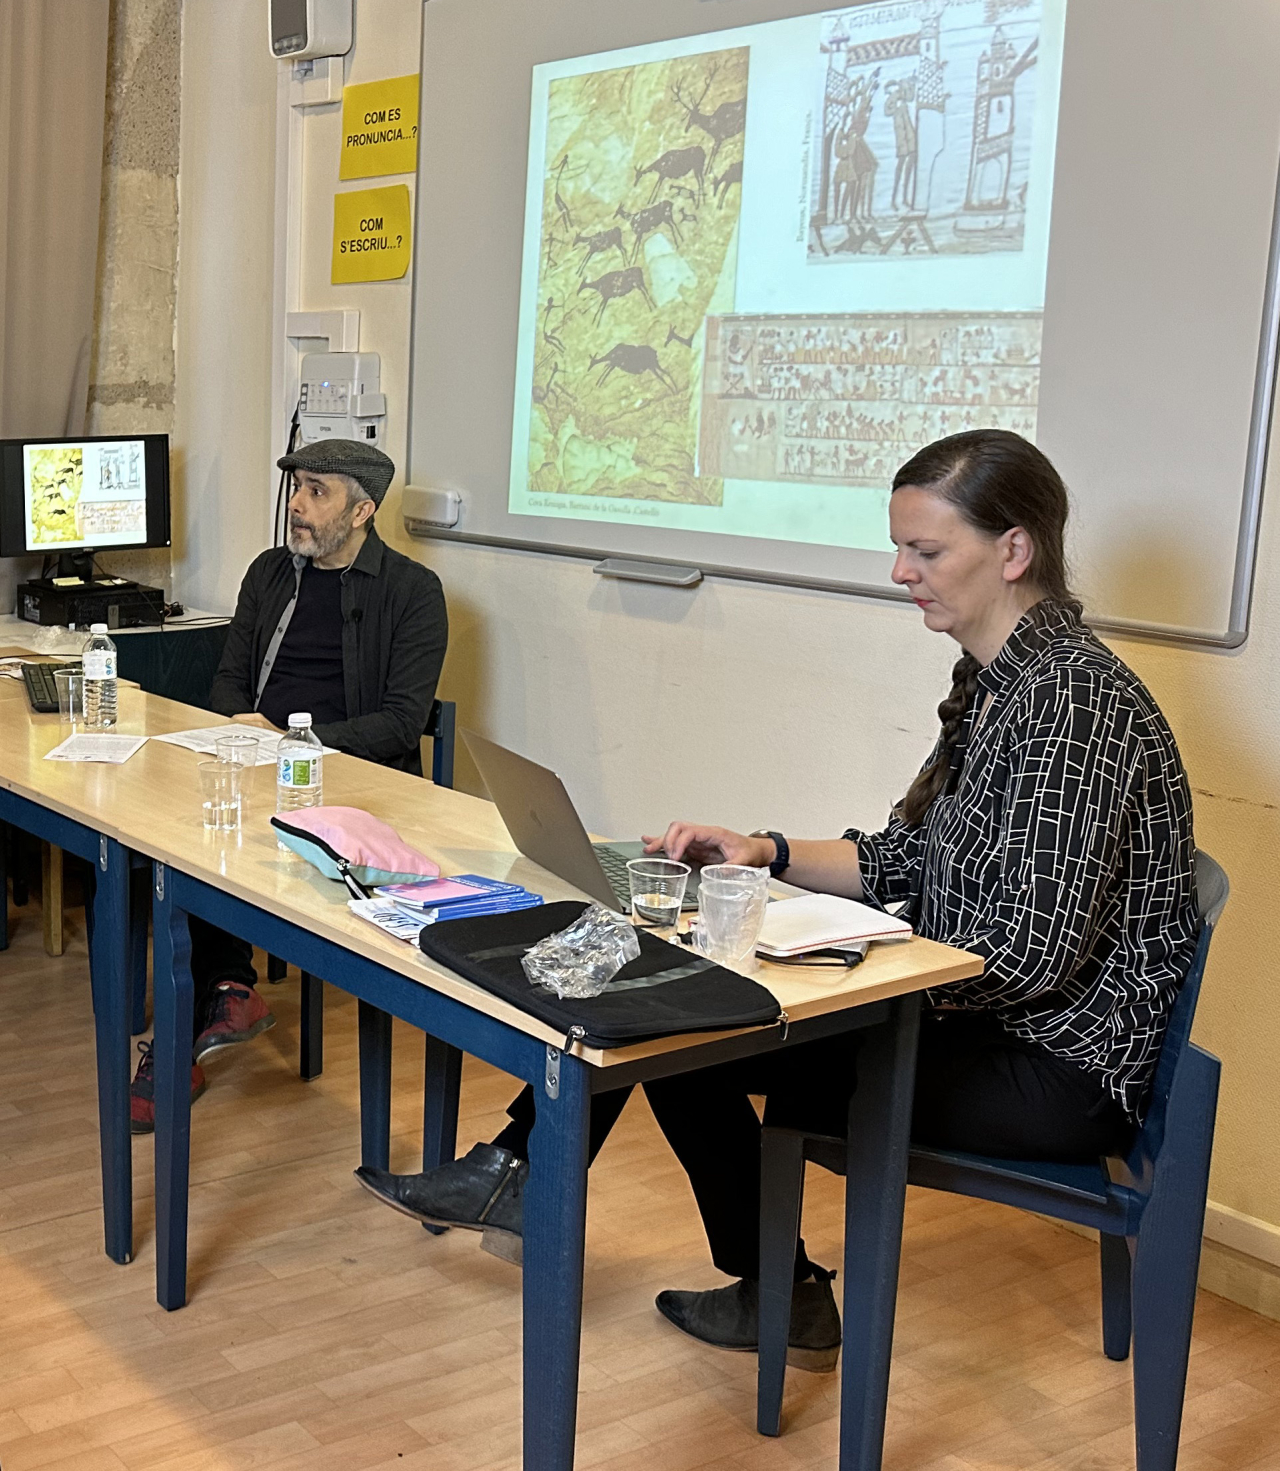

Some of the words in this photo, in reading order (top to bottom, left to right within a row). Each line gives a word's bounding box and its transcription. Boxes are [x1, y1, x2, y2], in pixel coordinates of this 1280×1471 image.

[363, 110, 386, 126] COM
[388, 107, 401, 122] ES
[346, 125, 418, 148] PRONUNCIA...?
[359, 217, 384, 232] COM
[340, 234, 403, 254] S'ESCRIU...?
